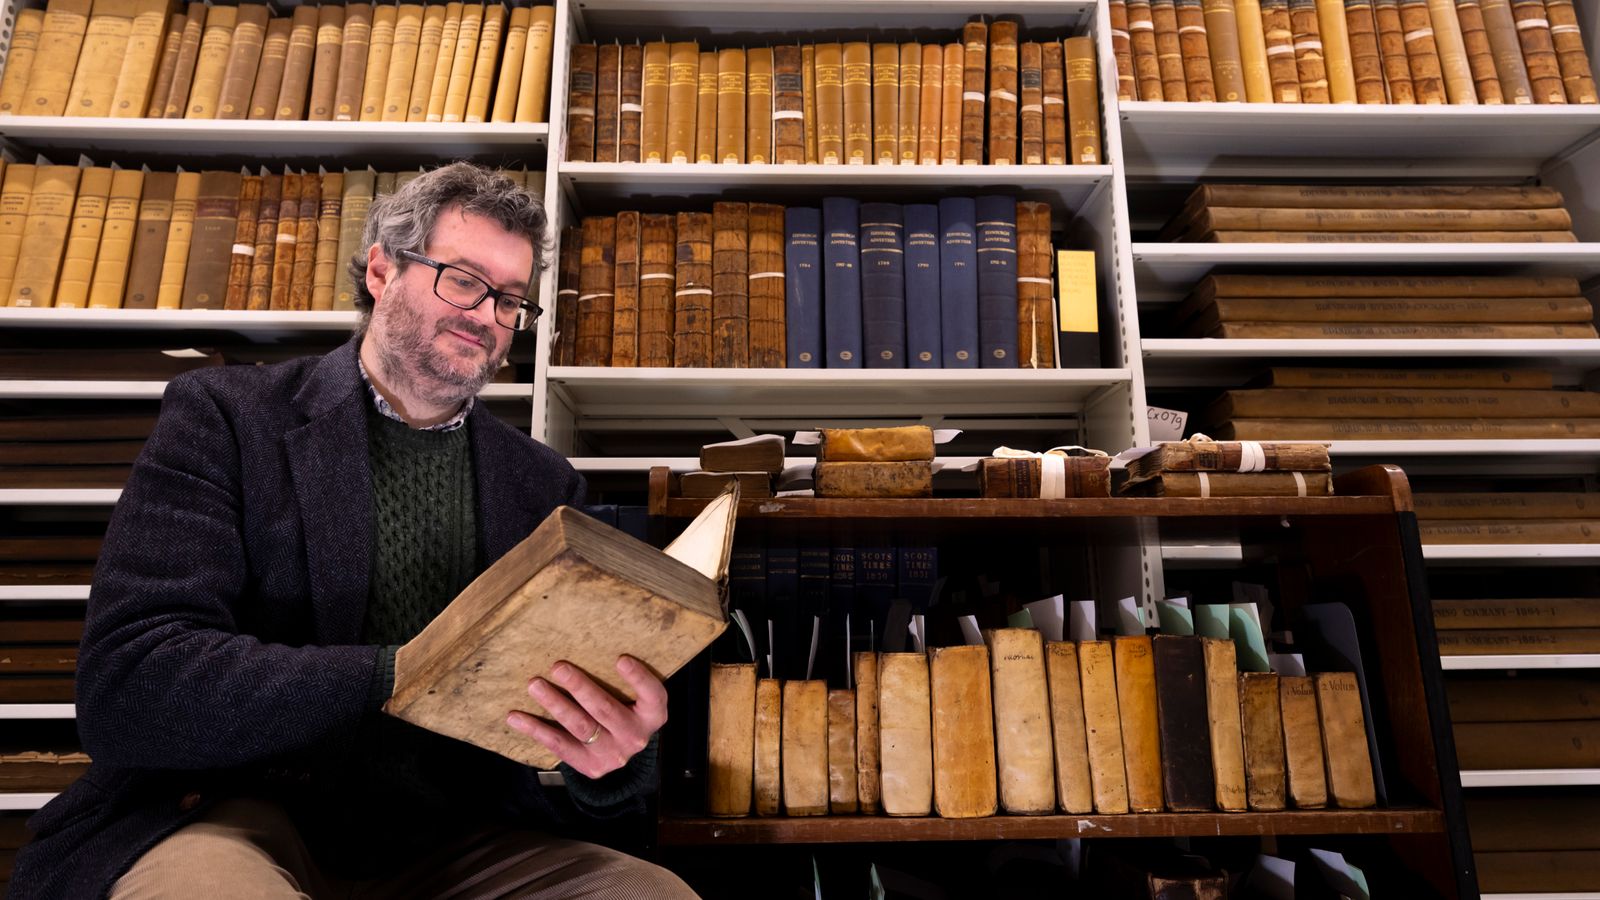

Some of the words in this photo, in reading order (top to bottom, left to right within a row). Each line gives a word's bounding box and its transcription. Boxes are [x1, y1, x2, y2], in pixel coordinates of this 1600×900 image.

[861, 552, 893, 561] SCOTS
[904, 552, 933, 561] SCOTS
[863, 561, 892, 569] TIMES
[905, 561, 933, 569] TIMES
[1321, 683, 1329, 691] 2
